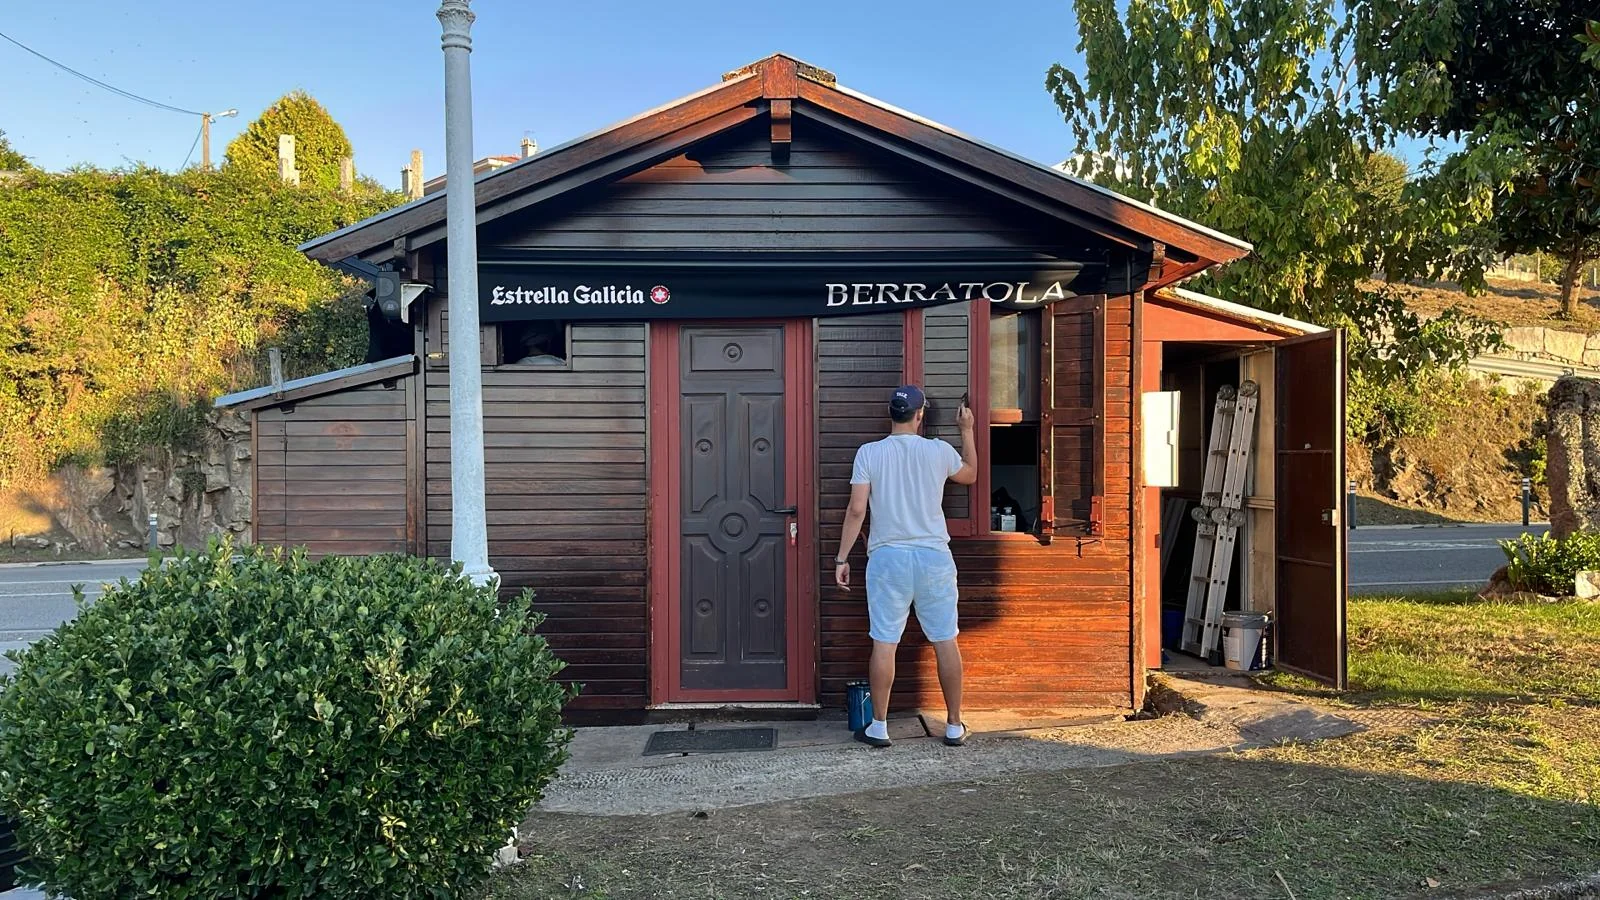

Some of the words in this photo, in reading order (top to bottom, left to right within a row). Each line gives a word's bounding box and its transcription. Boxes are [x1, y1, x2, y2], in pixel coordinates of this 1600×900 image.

[490, 285, 570, 305] Estrella
[573, 284, 646, 305] Galicia
[825, 281, 1066, 307] BERRATOLA
